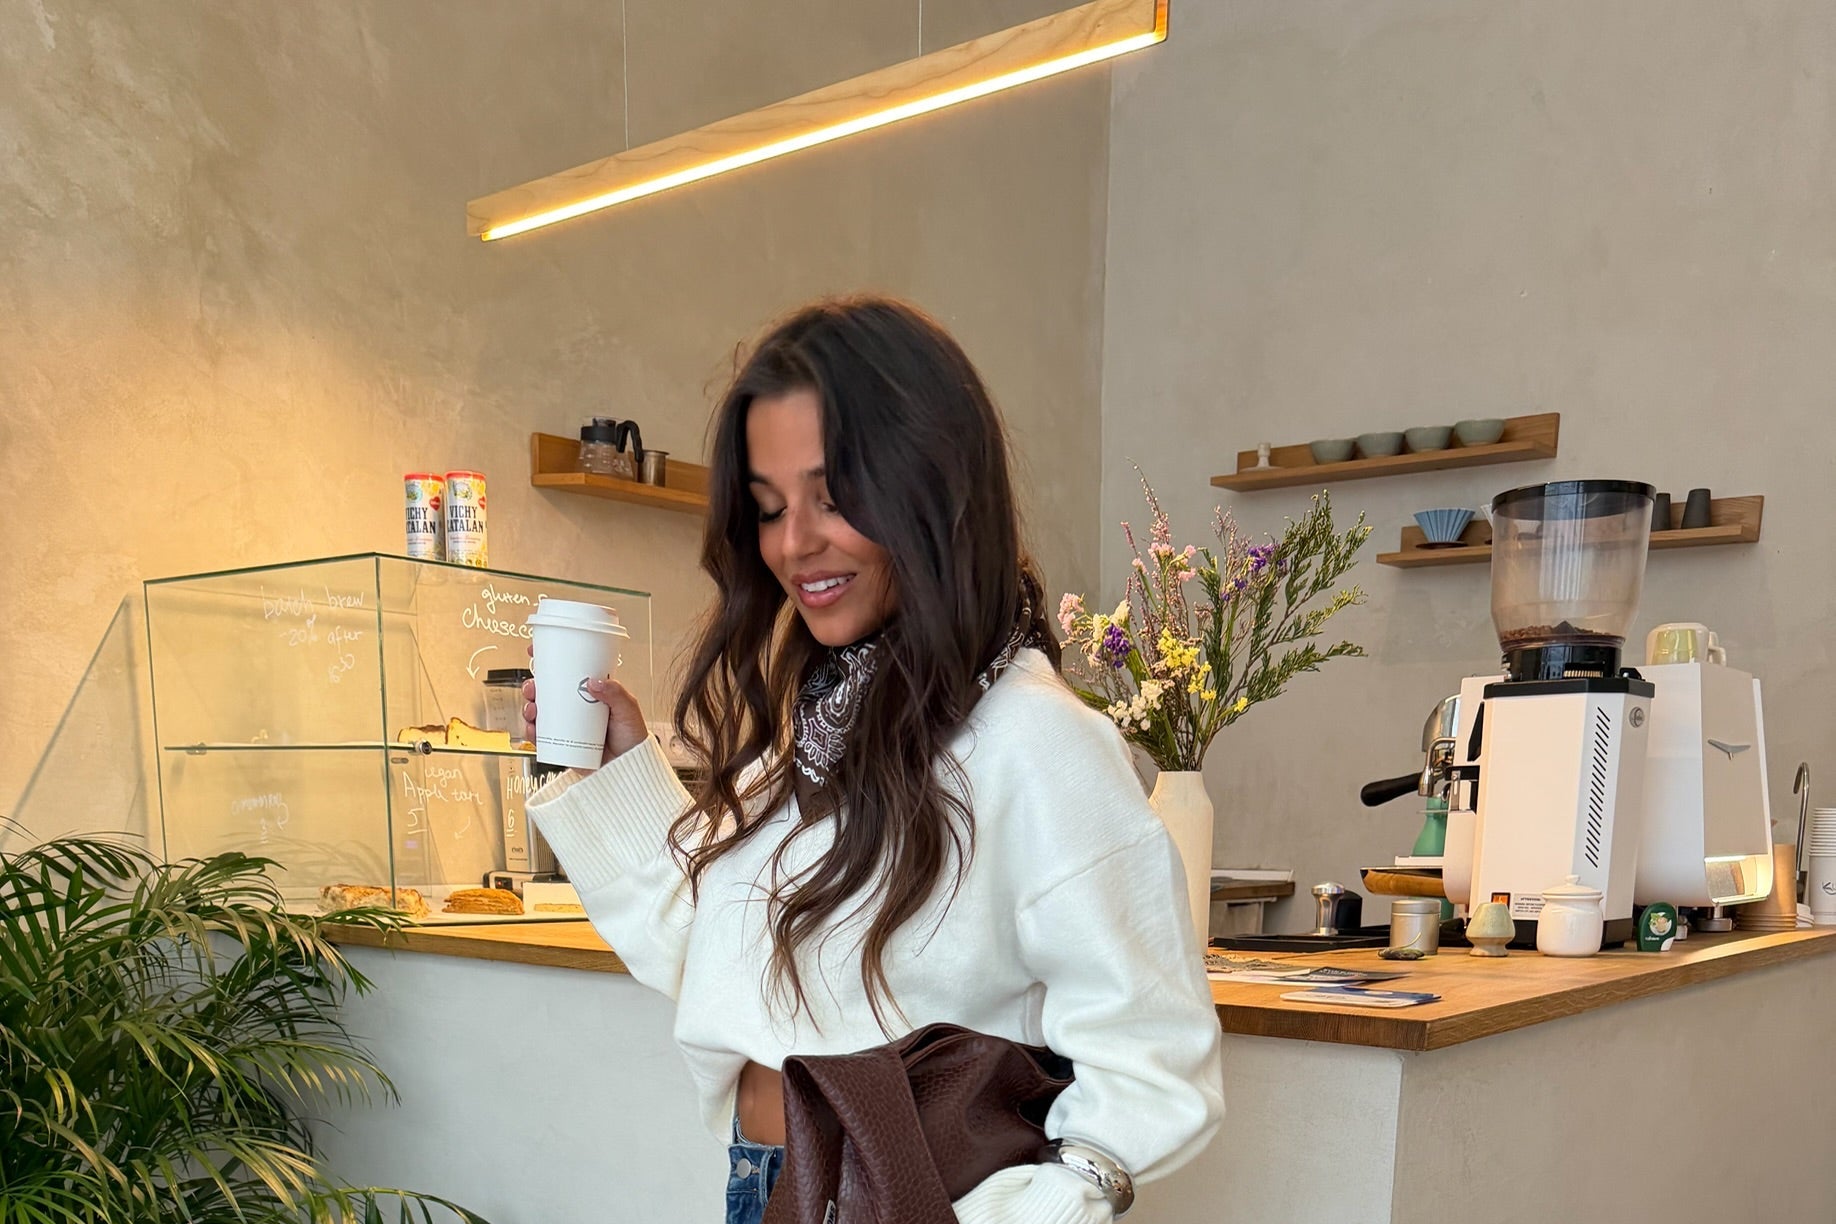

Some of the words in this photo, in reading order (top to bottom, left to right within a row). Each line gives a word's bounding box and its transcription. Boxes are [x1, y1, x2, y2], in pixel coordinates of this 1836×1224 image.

[449, 505, 478, 519] VICHY
[325, 585, 365, 610] brew
[327, 625, 363, 654] after
